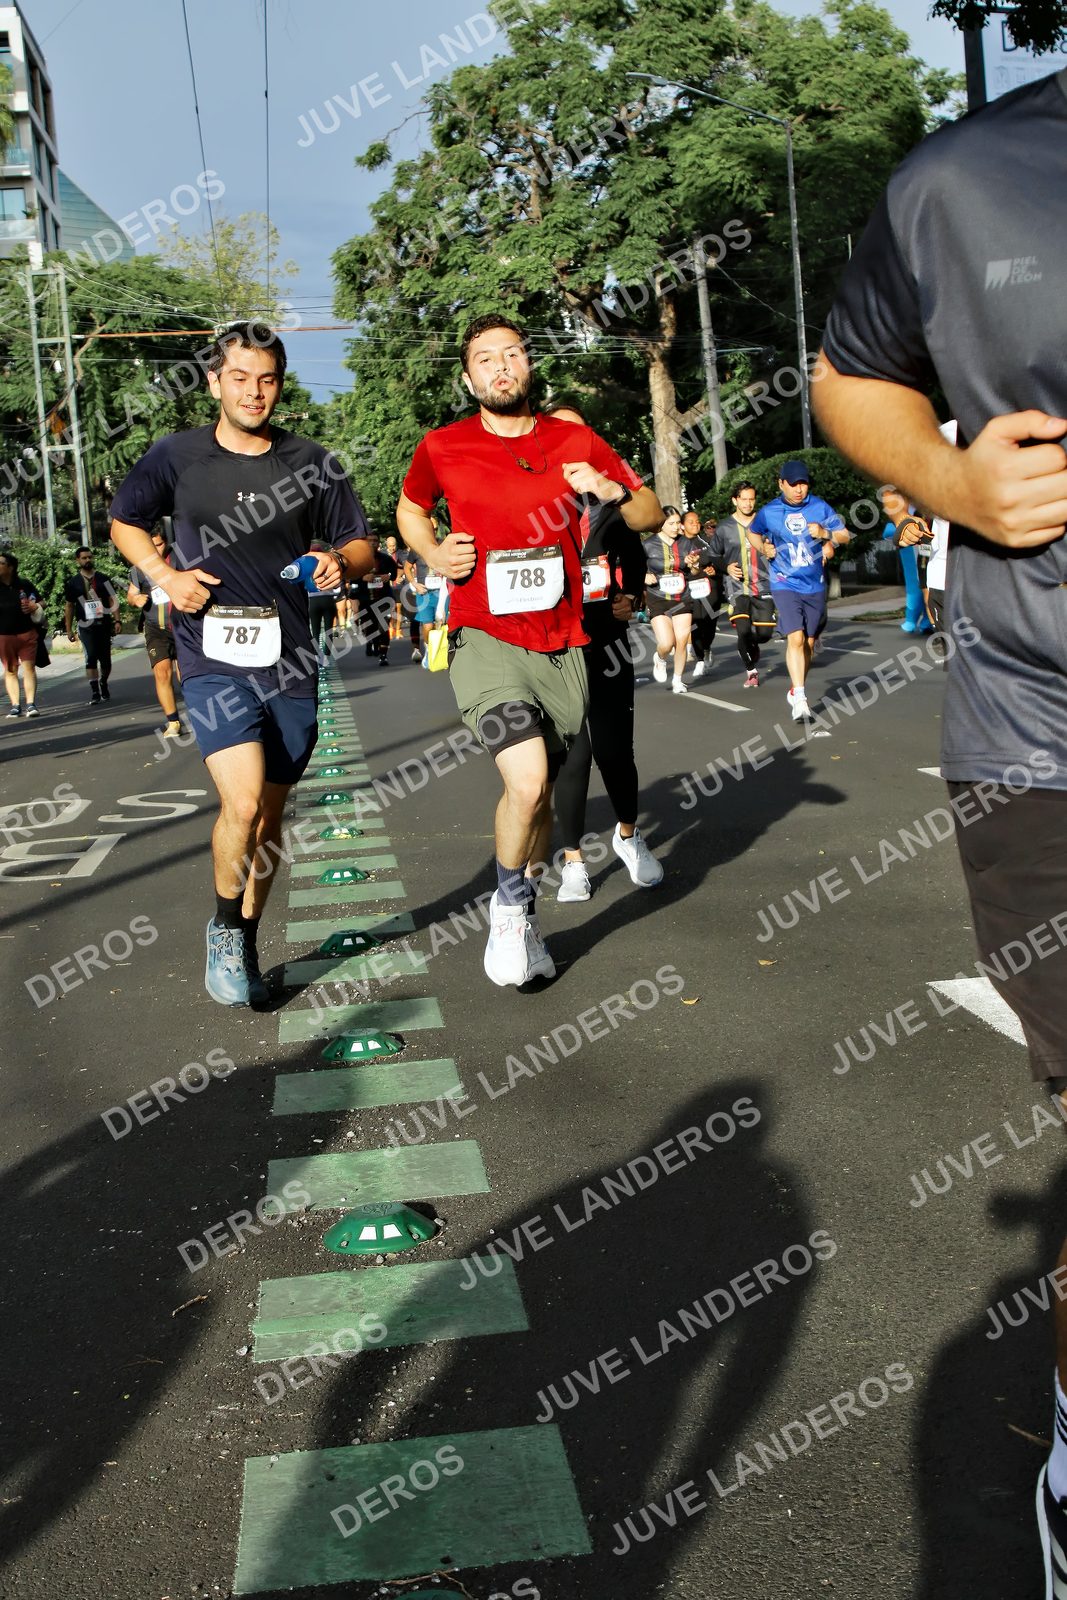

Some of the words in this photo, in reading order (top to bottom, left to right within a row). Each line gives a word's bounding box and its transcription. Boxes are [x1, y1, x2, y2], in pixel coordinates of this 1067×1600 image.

[1013, 255, 1038, 266] PIEL
[507, 567, 546, 590] 788
[223, 625, 261, 645] 787
